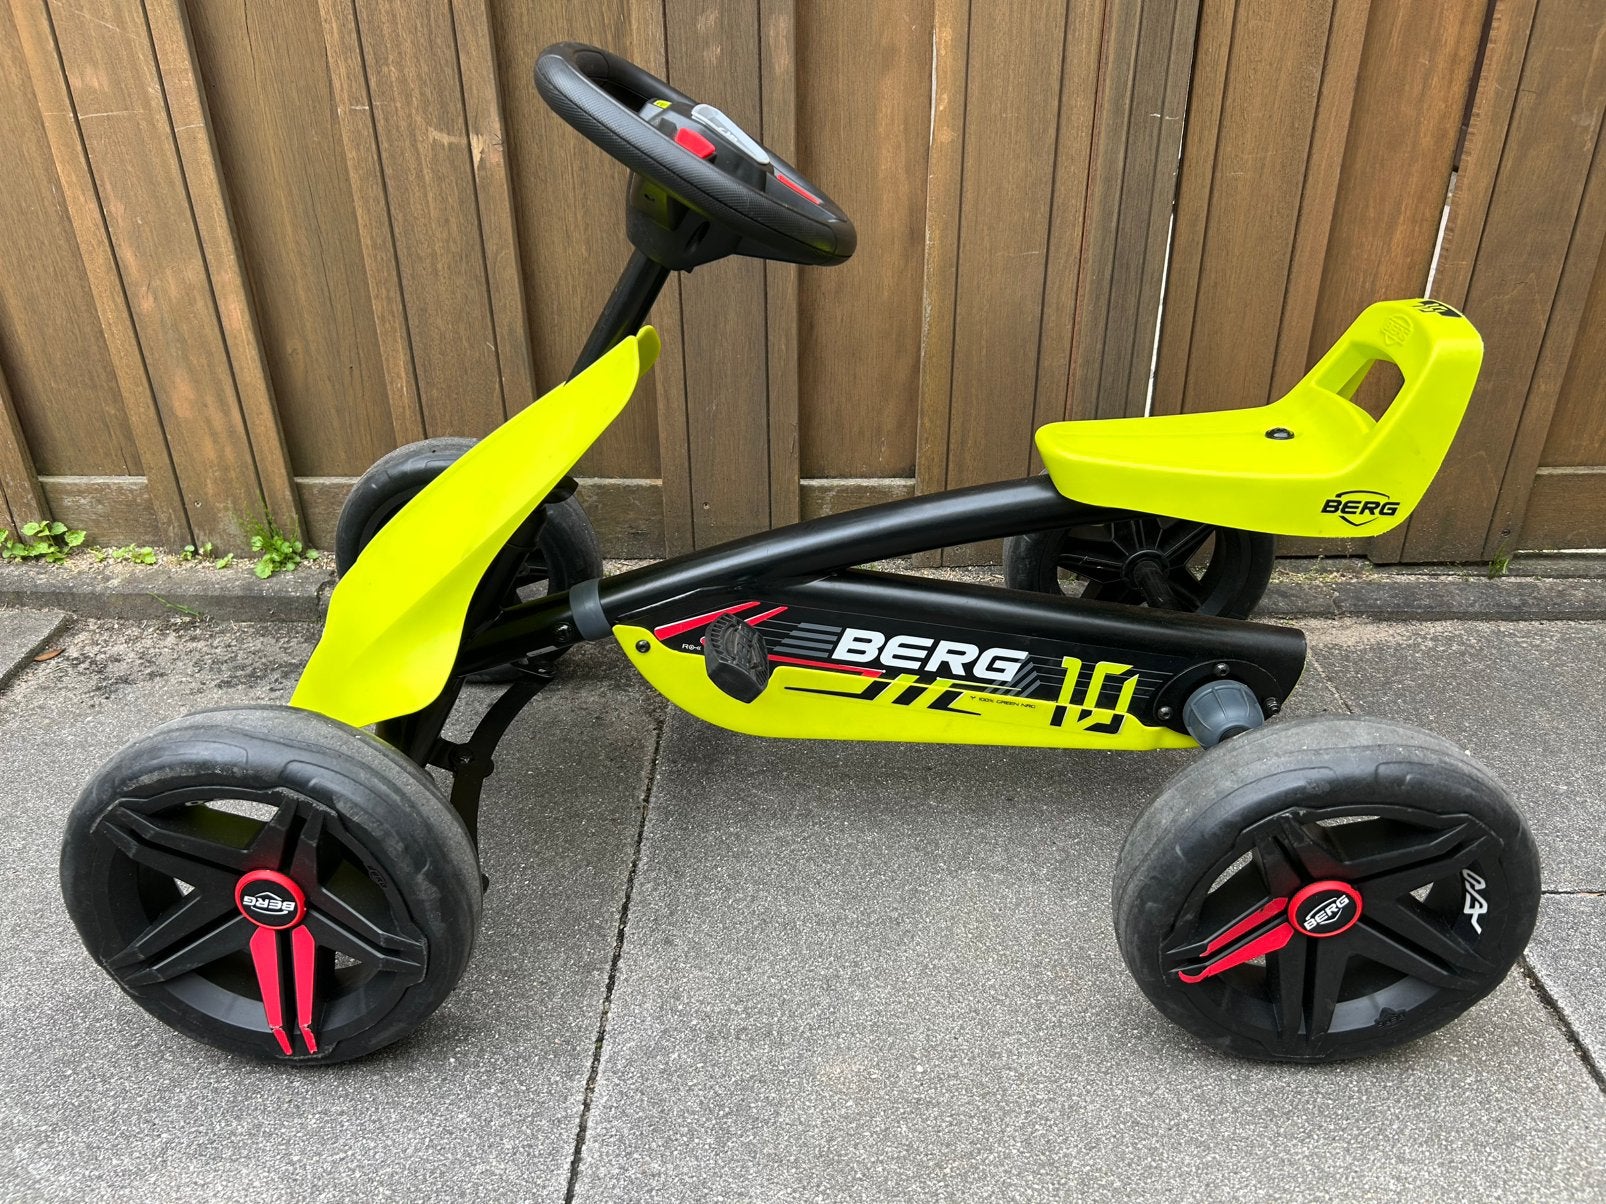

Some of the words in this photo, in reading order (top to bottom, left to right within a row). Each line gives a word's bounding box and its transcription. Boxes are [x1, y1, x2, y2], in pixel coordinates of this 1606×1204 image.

[1321, 498, 1401, 517] BERG
[831, 627, 1030, 682] BERG
[1049, 655, 1140, 735] 10
[242, 895, 296, 911] BERG
[1304, 894, 1350, 931] BERG
